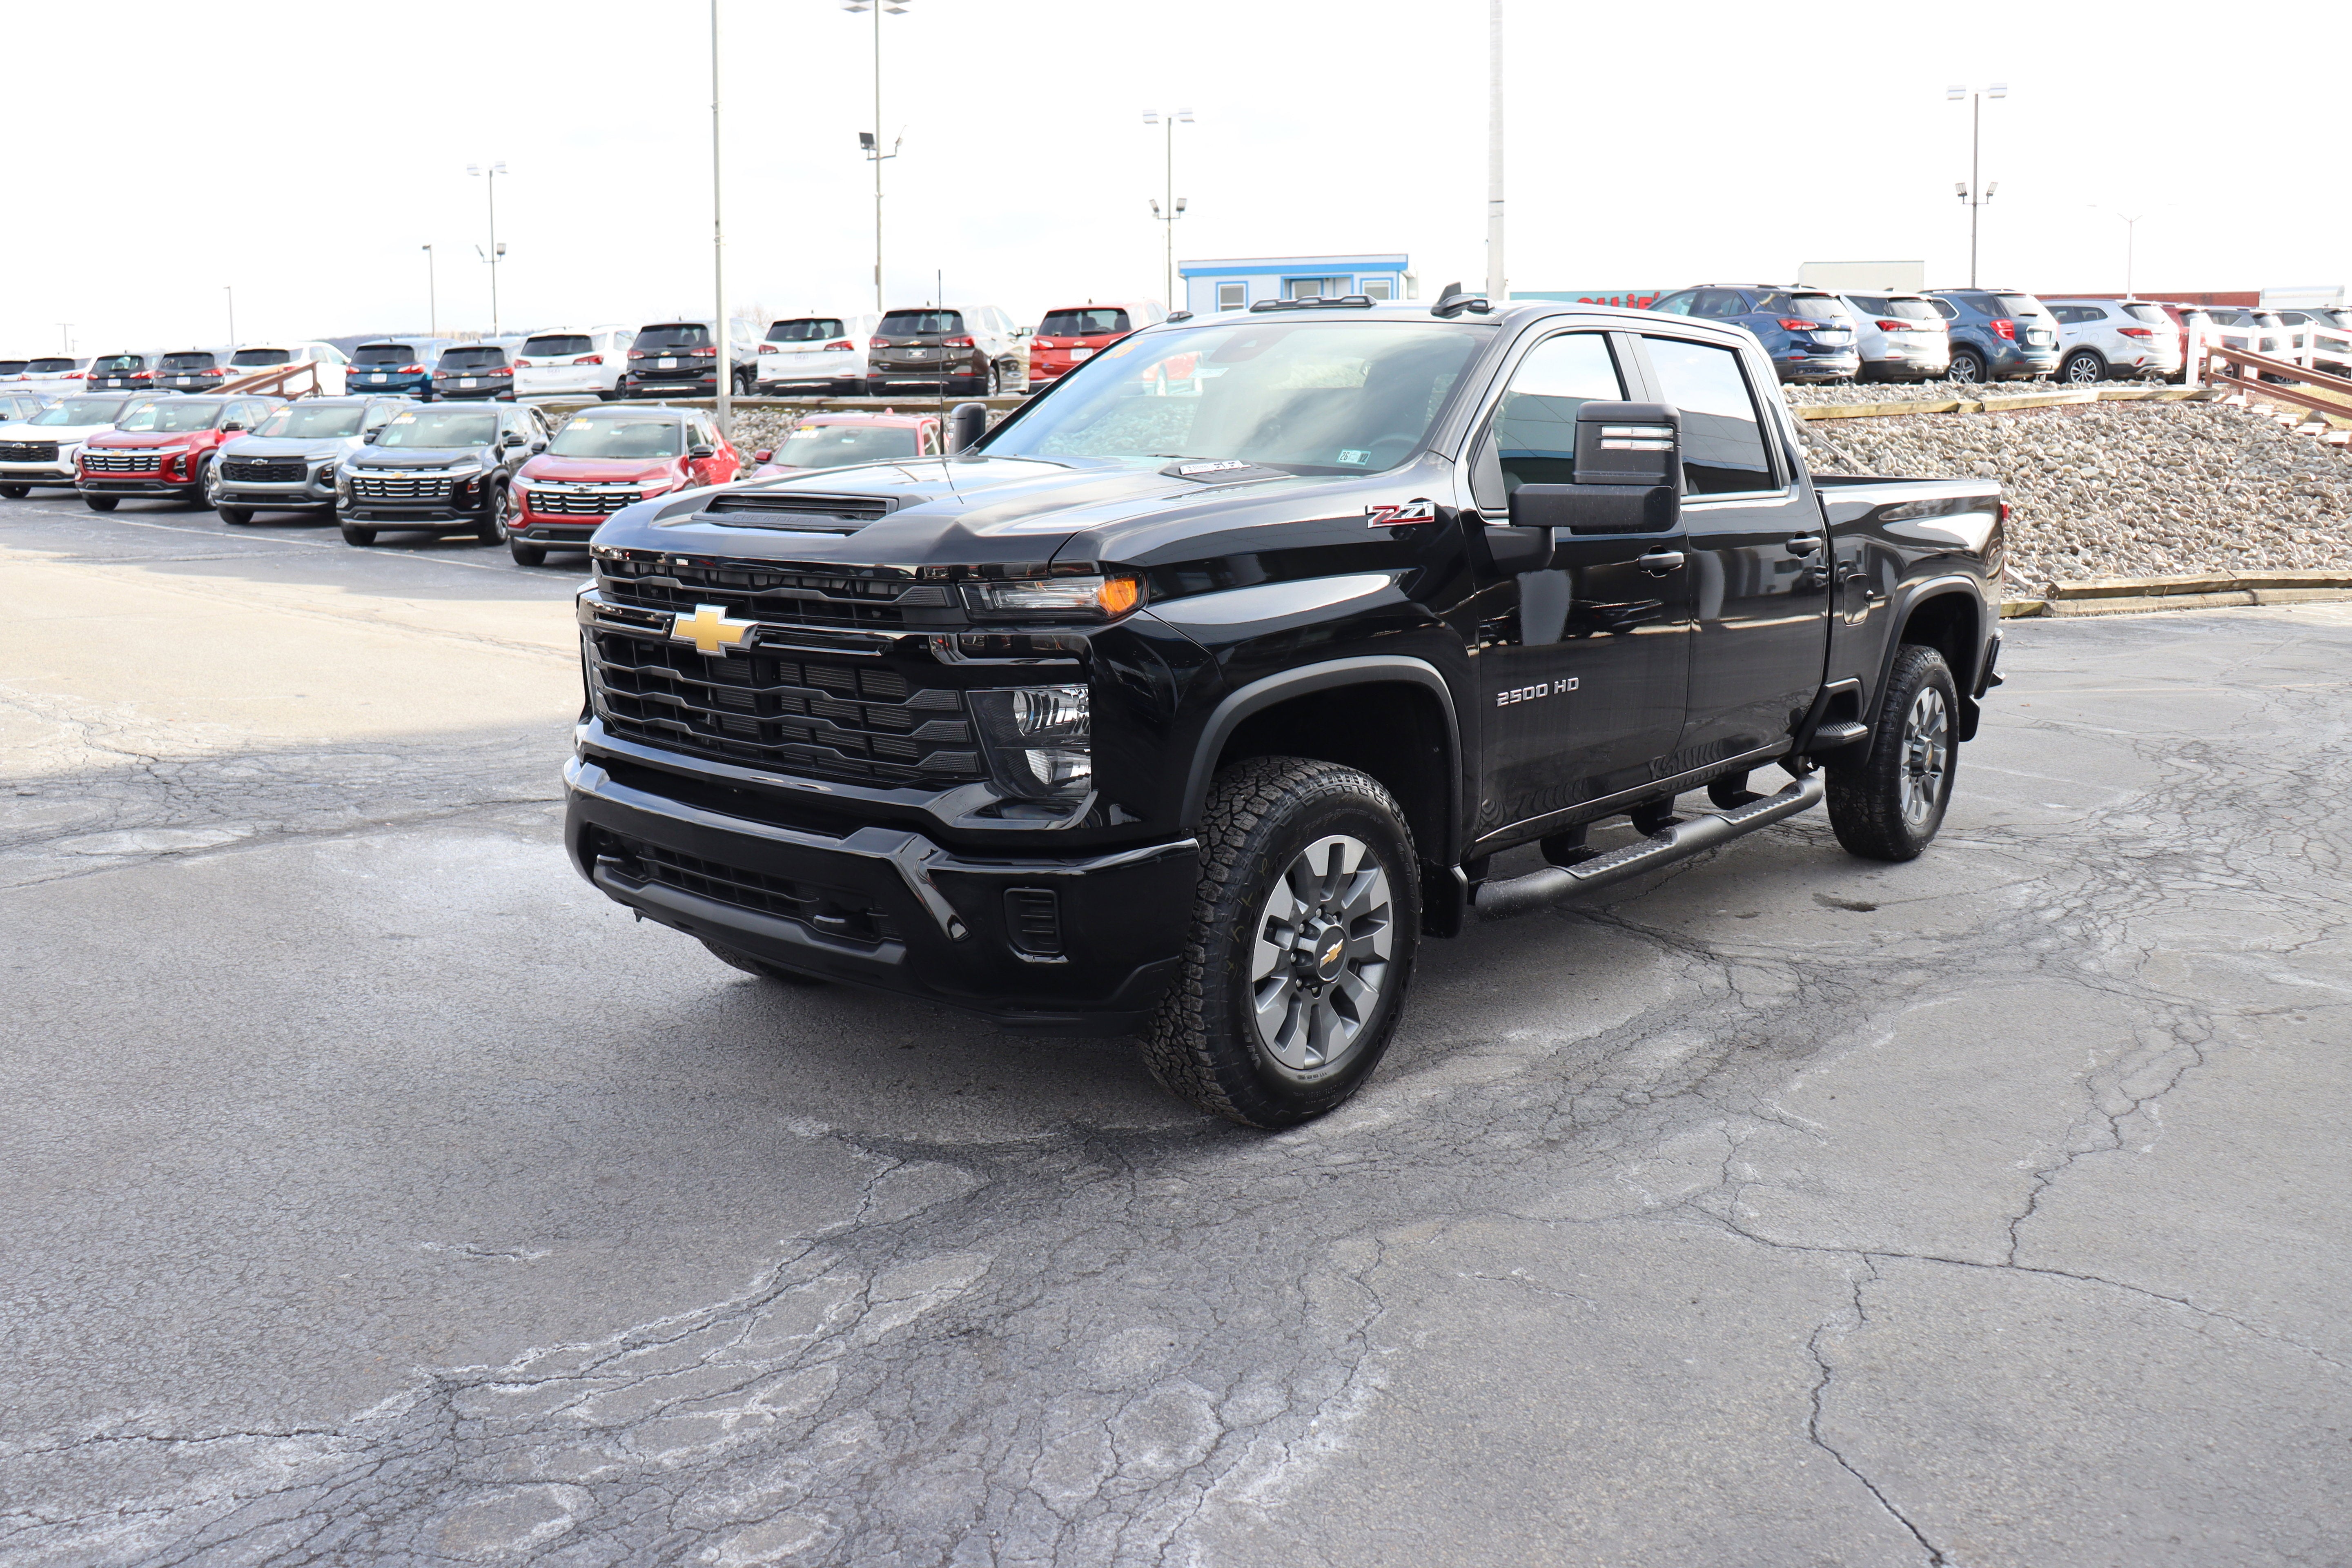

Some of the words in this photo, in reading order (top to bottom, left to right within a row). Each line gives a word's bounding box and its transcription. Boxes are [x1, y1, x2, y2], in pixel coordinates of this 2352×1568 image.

[789, 430, 820, 439] AWD
[1340, 451, 1350, 461] 26
[1359, 453, 1369, 463] 12
[733, 514, 818, 524] CHEVROLET
[1365, 501, 1435, 529] Z71
[1496, 683, 1548, 707] 2500
[1553, 677, 1579, 694] HD
